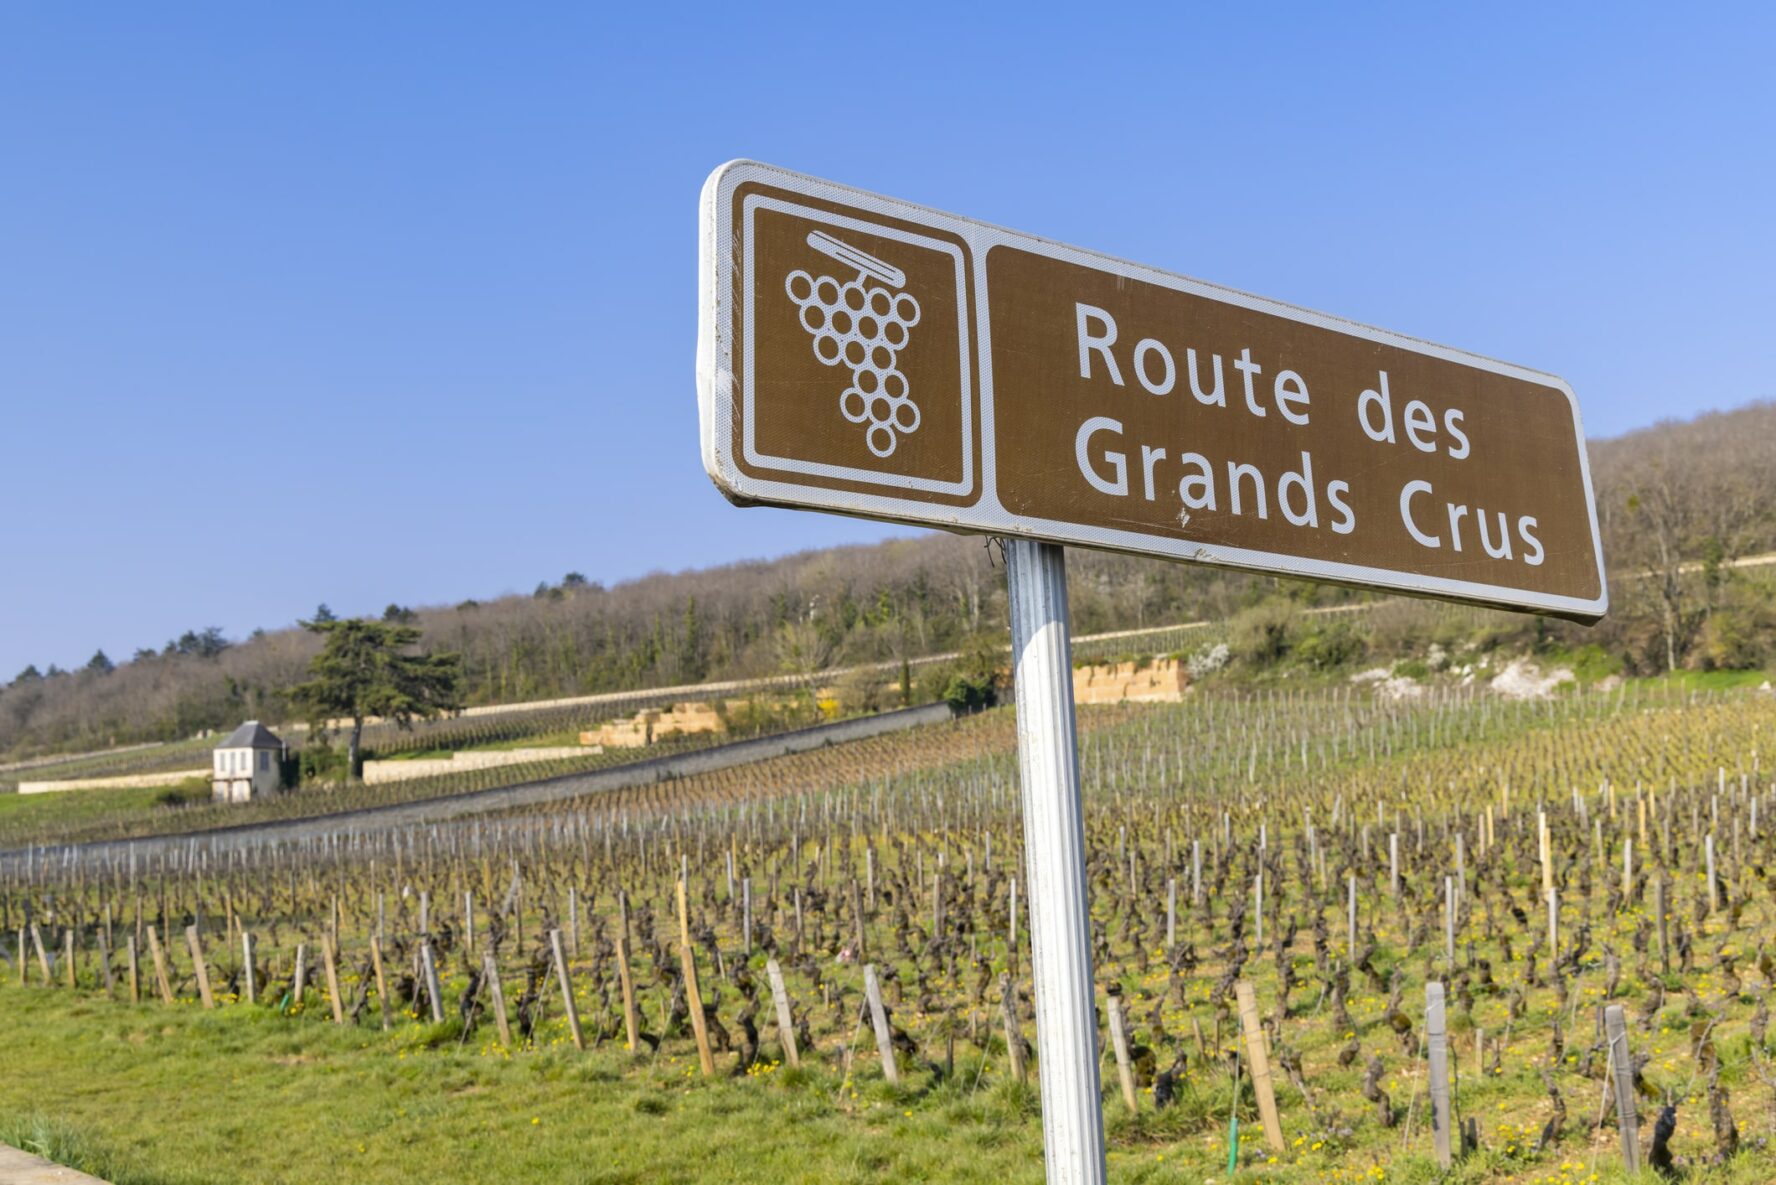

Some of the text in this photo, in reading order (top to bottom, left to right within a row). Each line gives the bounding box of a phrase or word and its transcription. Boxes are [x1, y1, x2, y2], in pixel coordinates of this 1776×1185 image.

[1075, 302, 1471, 460] Route des
[1075, 416, 1545, 566] Grands Crus
